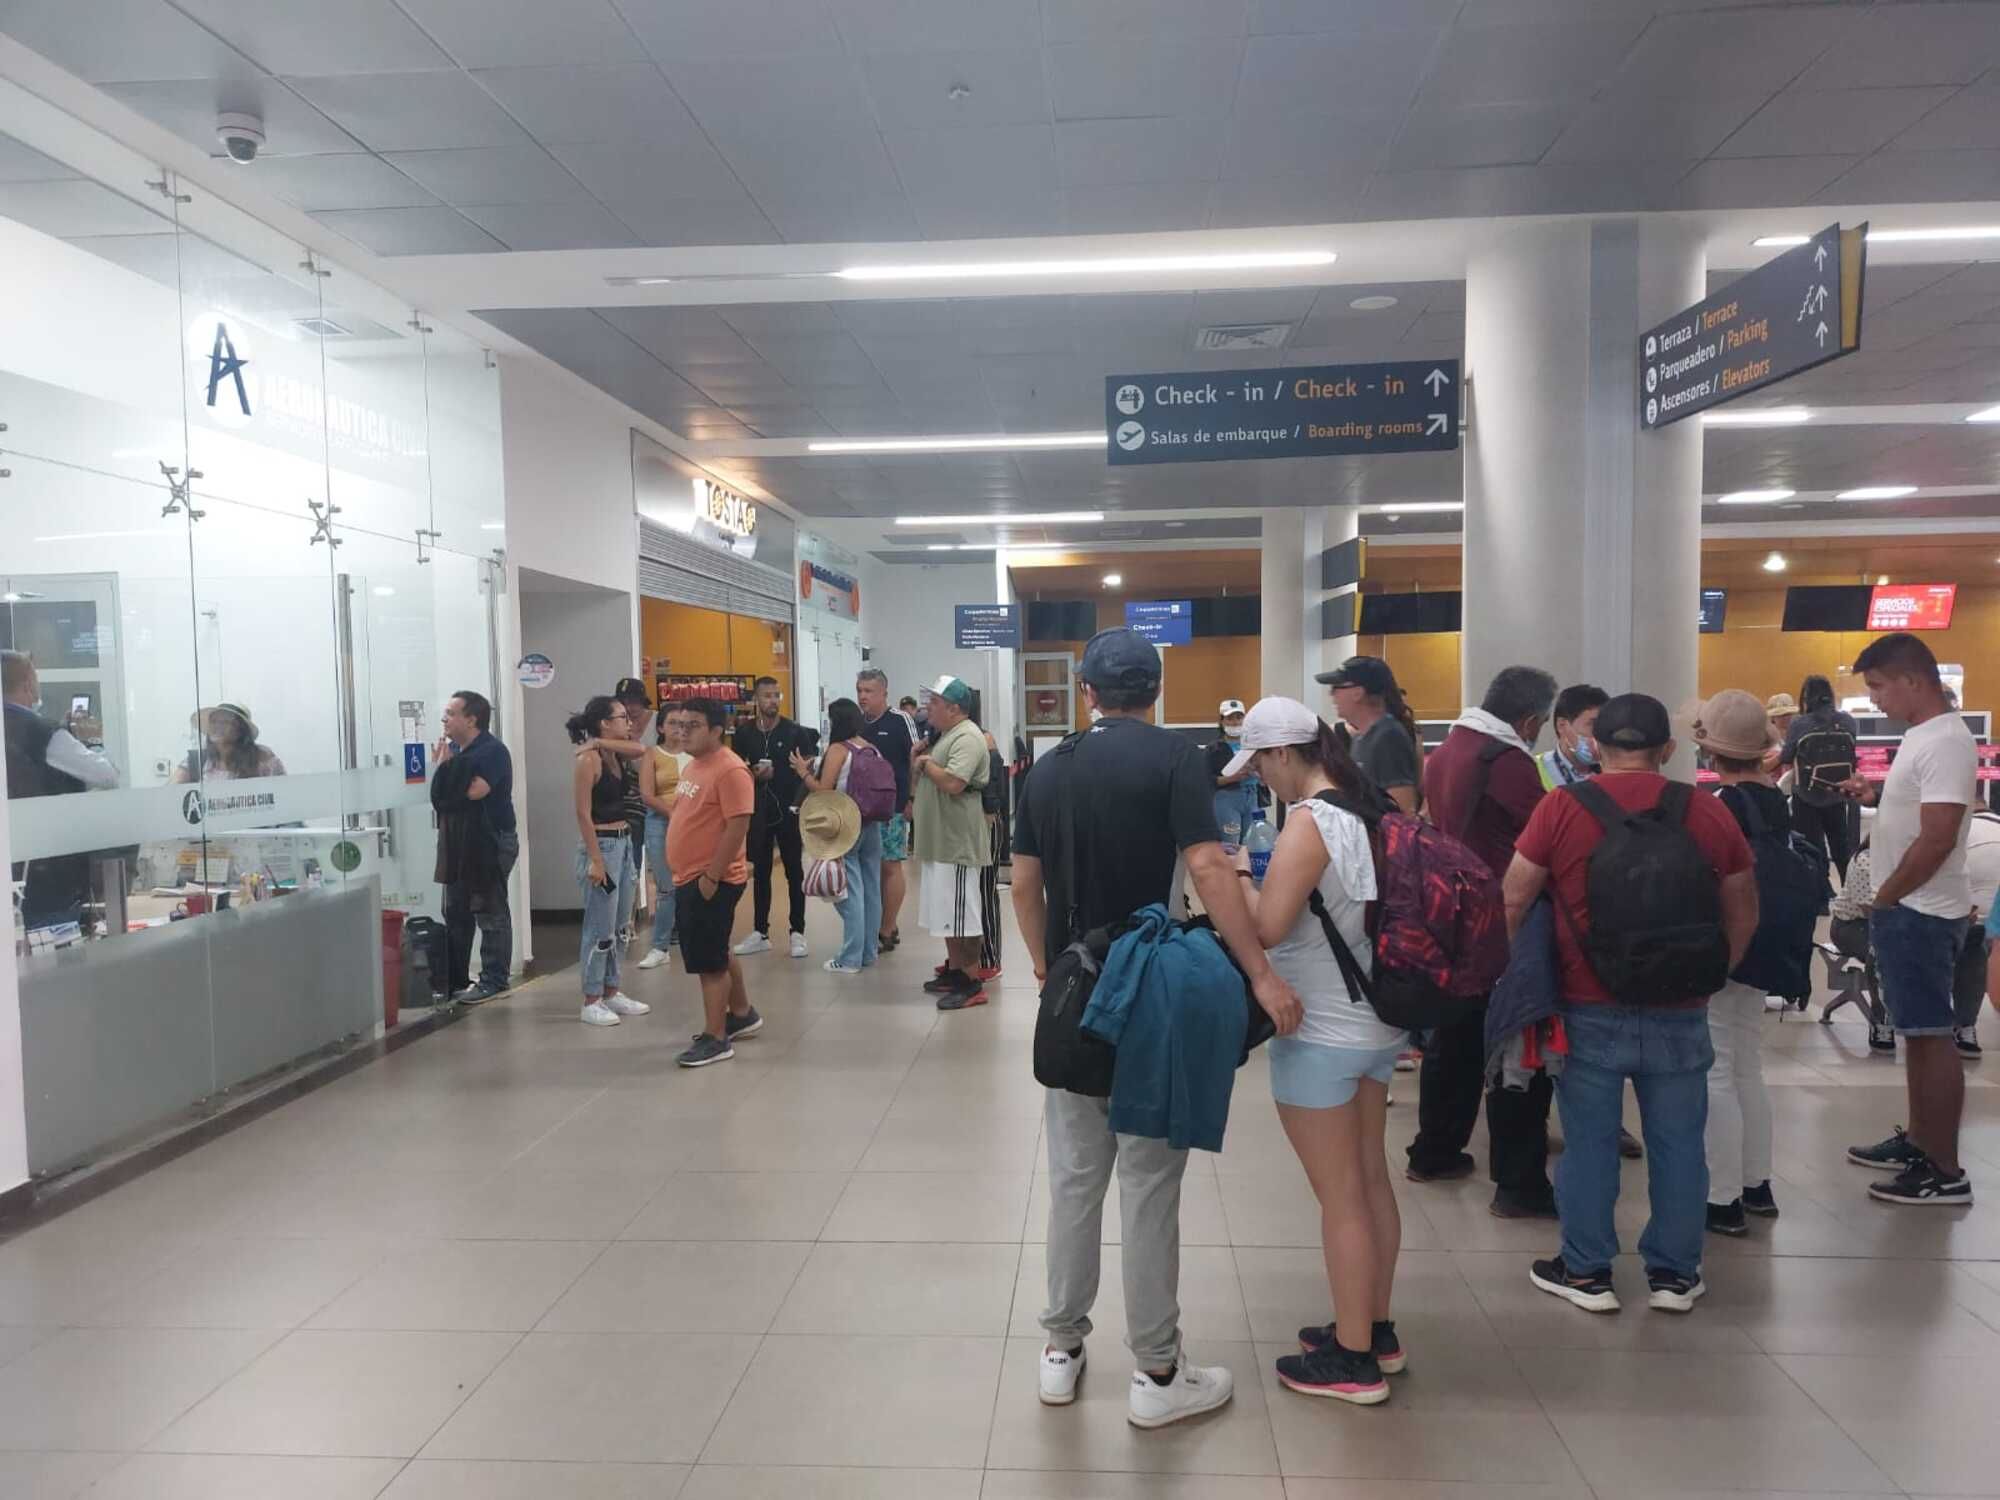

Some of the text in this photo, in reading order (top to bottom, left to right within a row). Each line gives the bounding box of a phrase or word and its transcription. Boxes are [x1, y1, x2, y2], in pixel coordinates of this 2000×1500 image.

[1659, 302, 1738, 352] Terraza / Terrace
[1659, 318, 1768, 381] Parqueadero / Parking
[1155, 384, 1218, 406] Check
[1244, 382, 1264, 401] in
[1273, 380, 1282, 401] /
[1294, 378, 1357, 400] Check
[1384, 375, 1405, 396] in
[1660, 358, 1771, 411] Ascensores / Elevators
[1151, 421, 1424, 446] Salas de embarque / Boarding rooms
